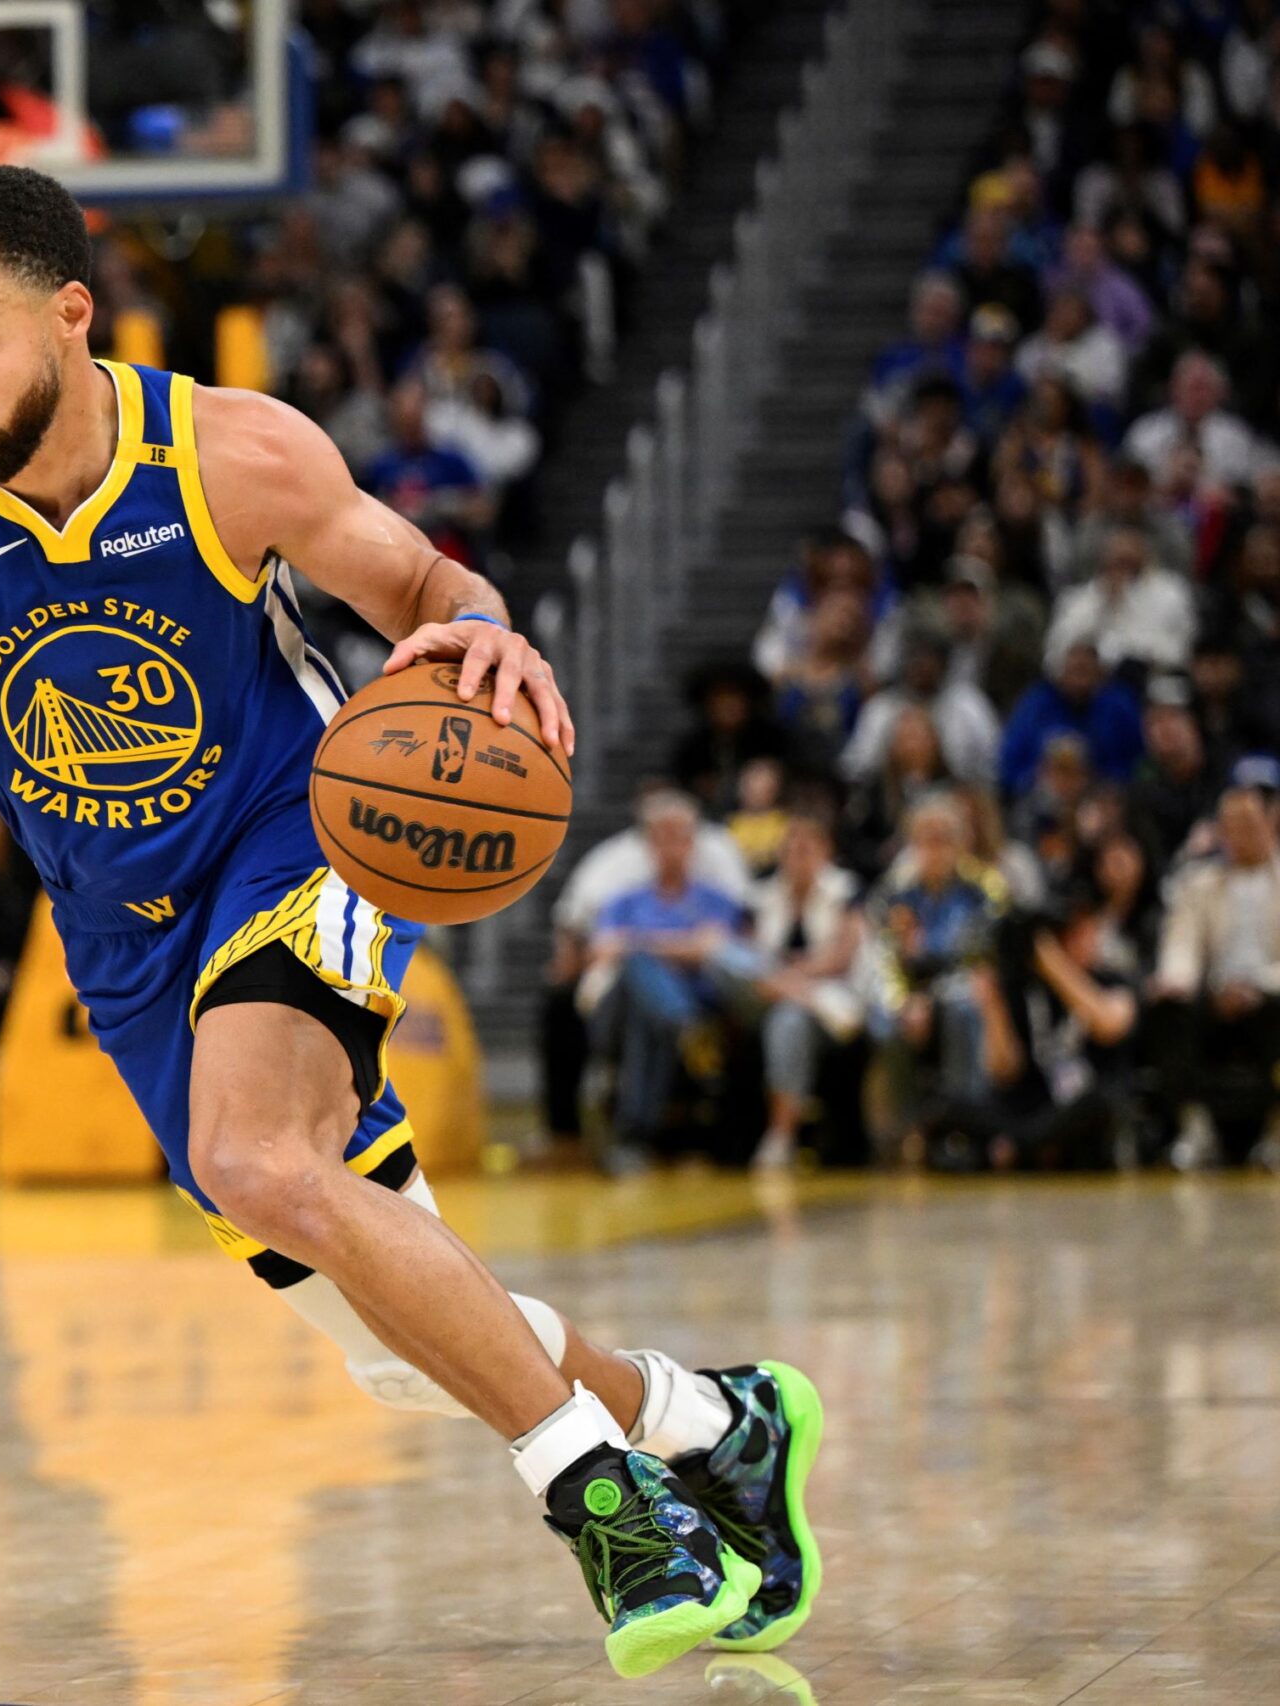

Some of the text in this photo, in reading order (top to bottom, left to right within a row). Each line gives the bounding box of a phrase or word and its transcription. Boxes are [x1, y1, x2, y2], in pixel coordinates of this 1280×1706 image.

[150, 447, 166, 463] 16
[100, 522, 185, 558] Rakuten
[104, 598, 191, 647] STATE
[97, 660, 175, 712] 30
[9, 744, 222, 829] WARRIORS
[349, 796, 517, 874] Wilson
